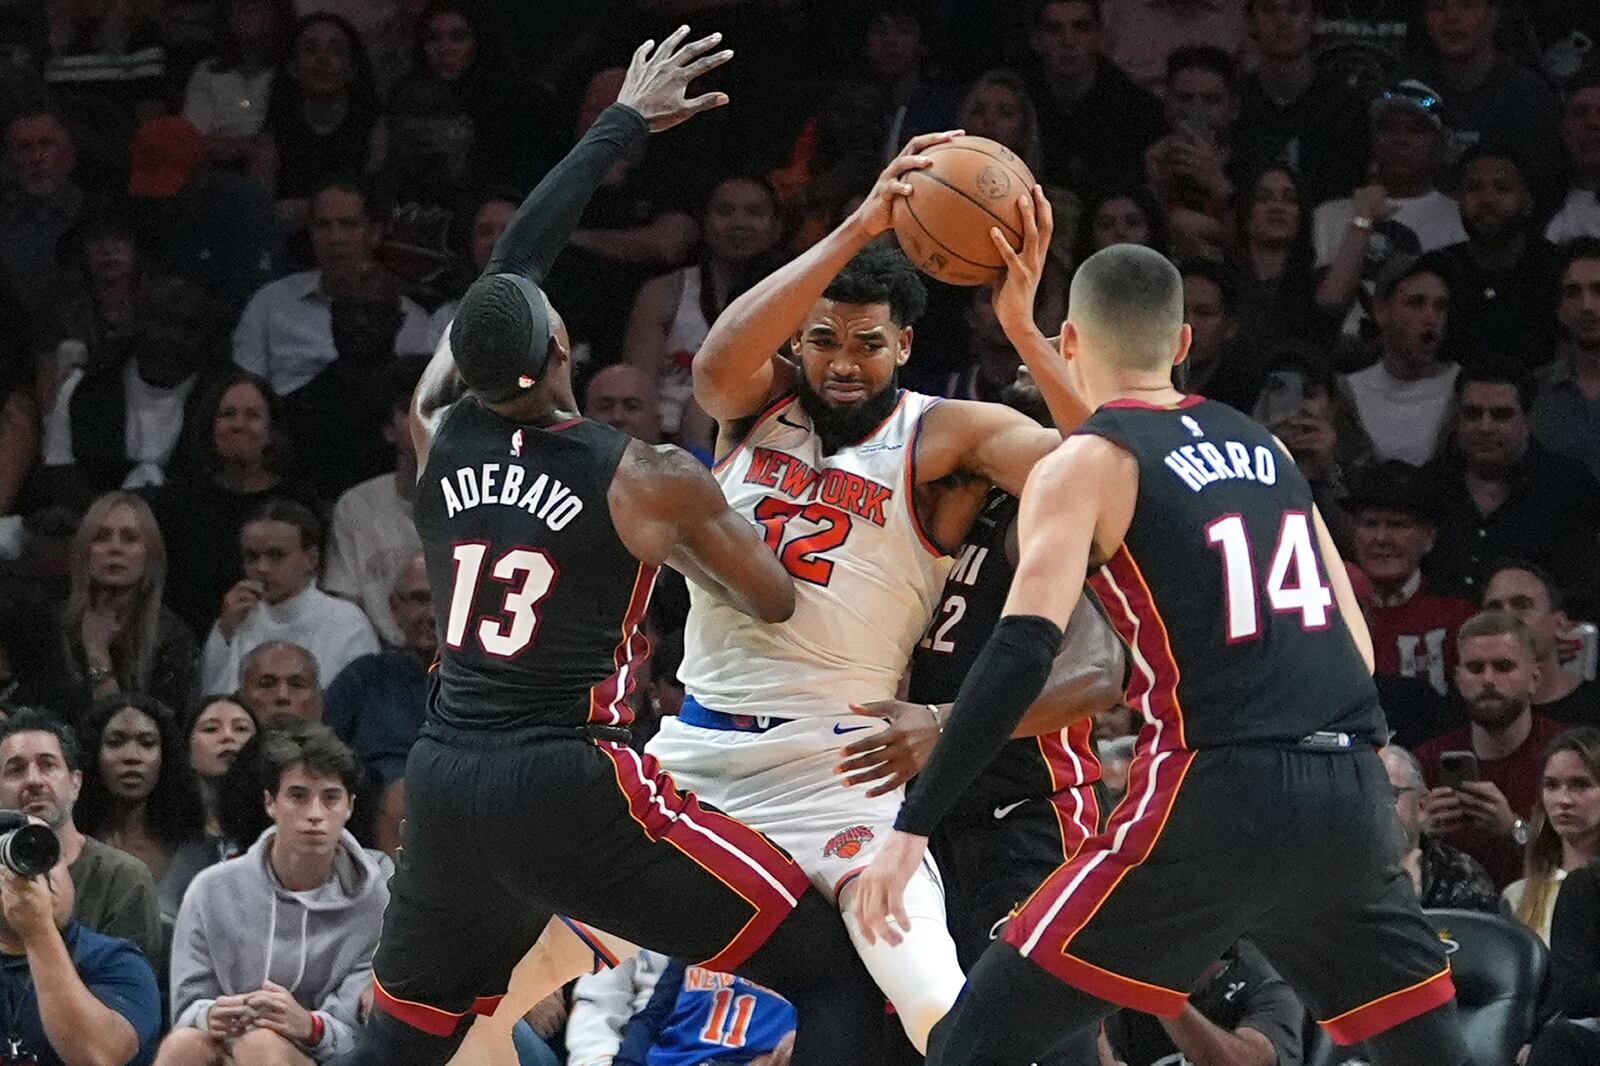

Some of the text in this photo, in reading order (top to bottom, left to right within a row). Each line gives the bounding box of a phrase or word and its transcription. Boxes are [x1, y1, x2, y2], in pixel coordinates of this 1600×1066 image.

[440, 463, 584, 532] ADEBAYO
[743, 446, 893, 528] NEW YORK
[1164, 440, 1277, 492] HERRO
[445, 539, 561, 661] 13
[1204, 511, 1335, 646] 14
[1397, 627, 1448, 697] H
[699, 987, 757, 1048] 11
